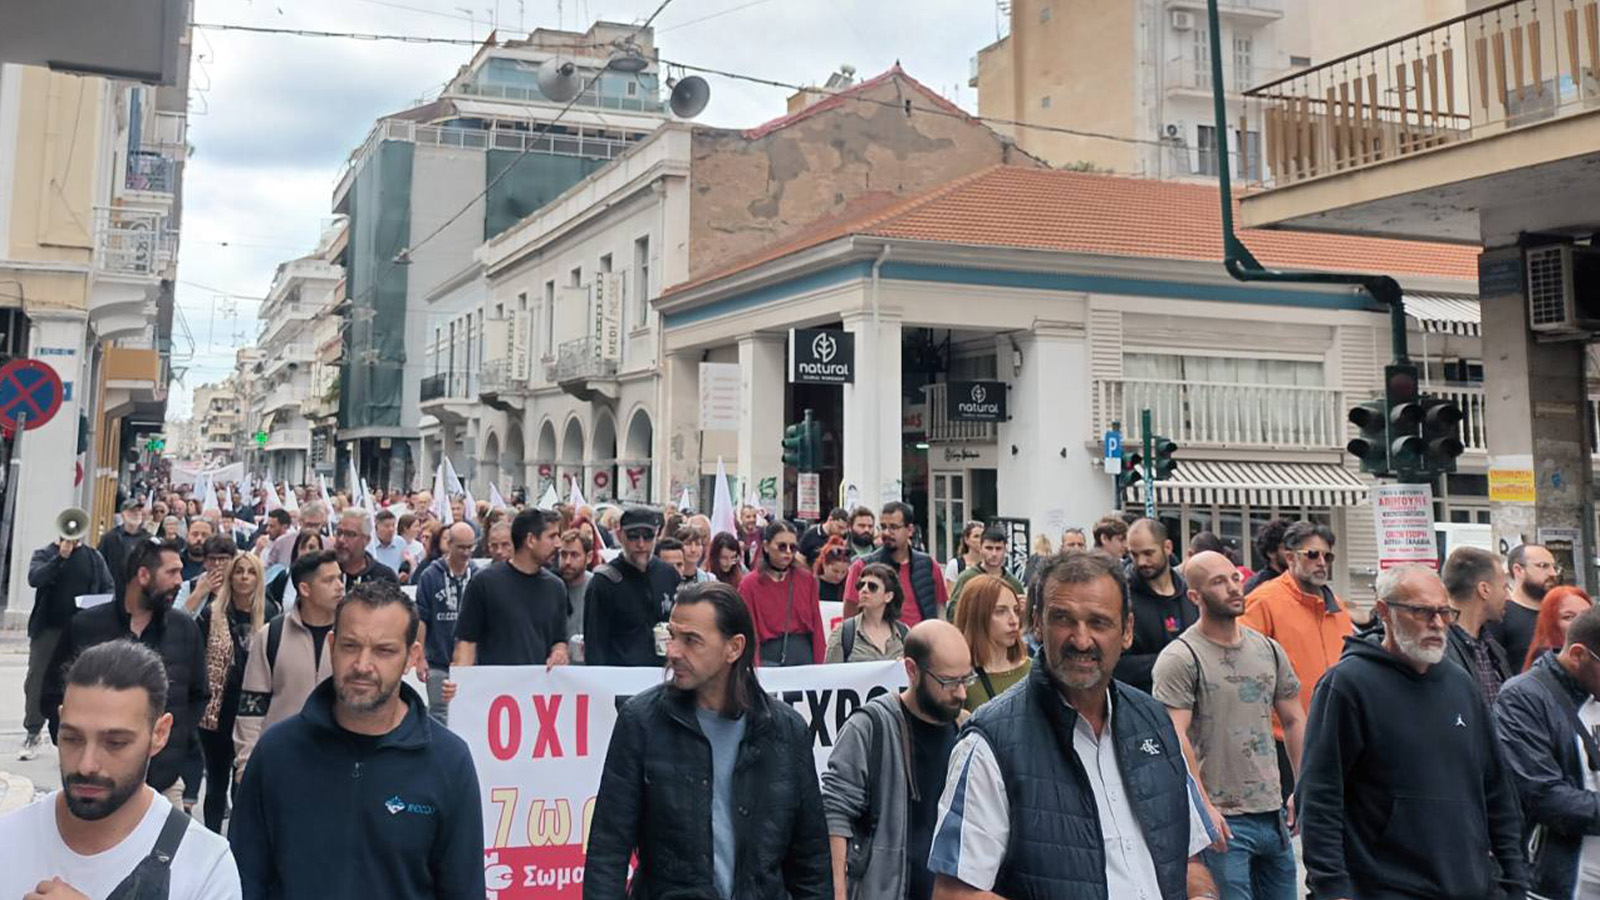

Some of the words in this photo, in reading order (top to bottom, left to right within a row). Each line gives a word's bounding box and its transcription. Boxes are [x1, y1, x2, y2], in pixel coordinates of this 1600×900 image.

[799, 363, 849, 375] natural
[958, 403, 999, 413] natural
[1108, 437, 1118, 458] P
[487, 694, 590, 761] ΟΧΙ
